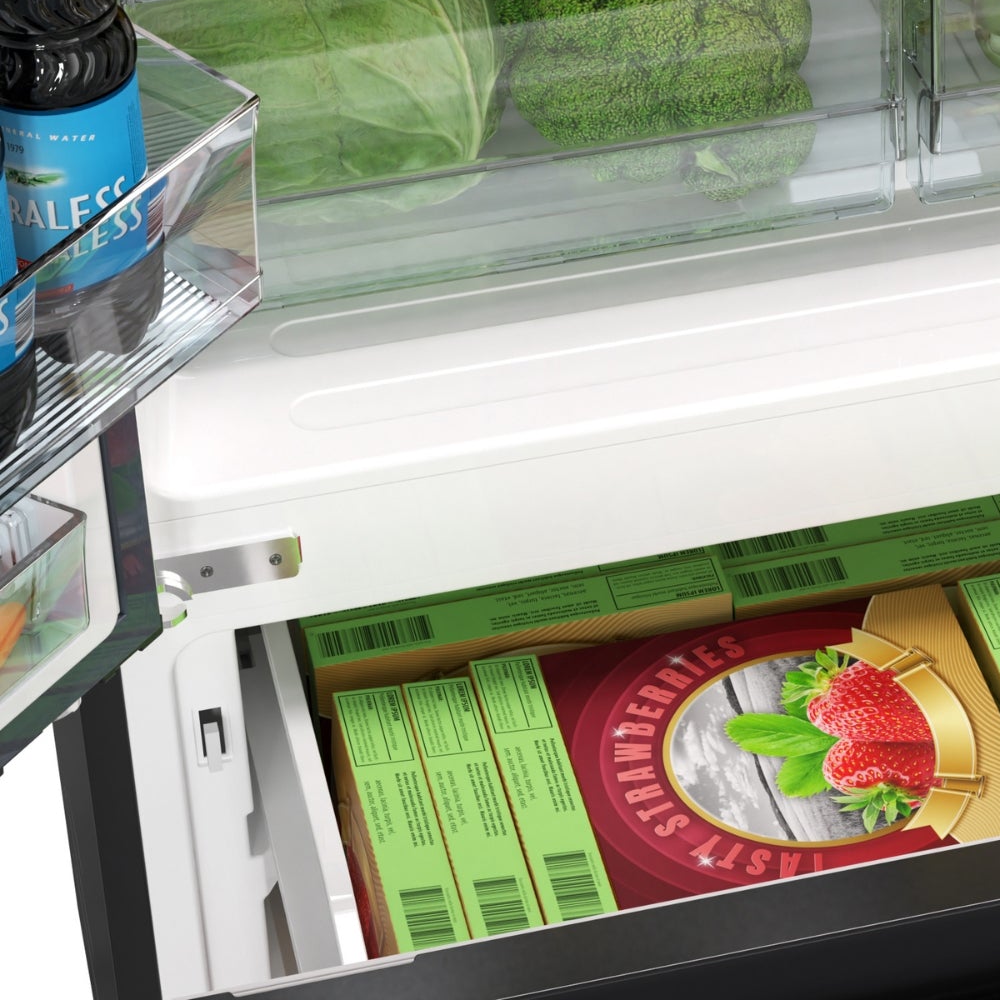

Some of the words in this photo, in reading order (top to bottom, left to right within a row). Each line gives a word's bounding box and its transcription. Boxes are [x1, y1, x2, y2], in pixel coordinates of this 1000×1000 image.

[49, 134, 96, 142] WATER
[6, 142, 25, 154] 1979
[613, 635, 746, 838] STRAWBERRIES
